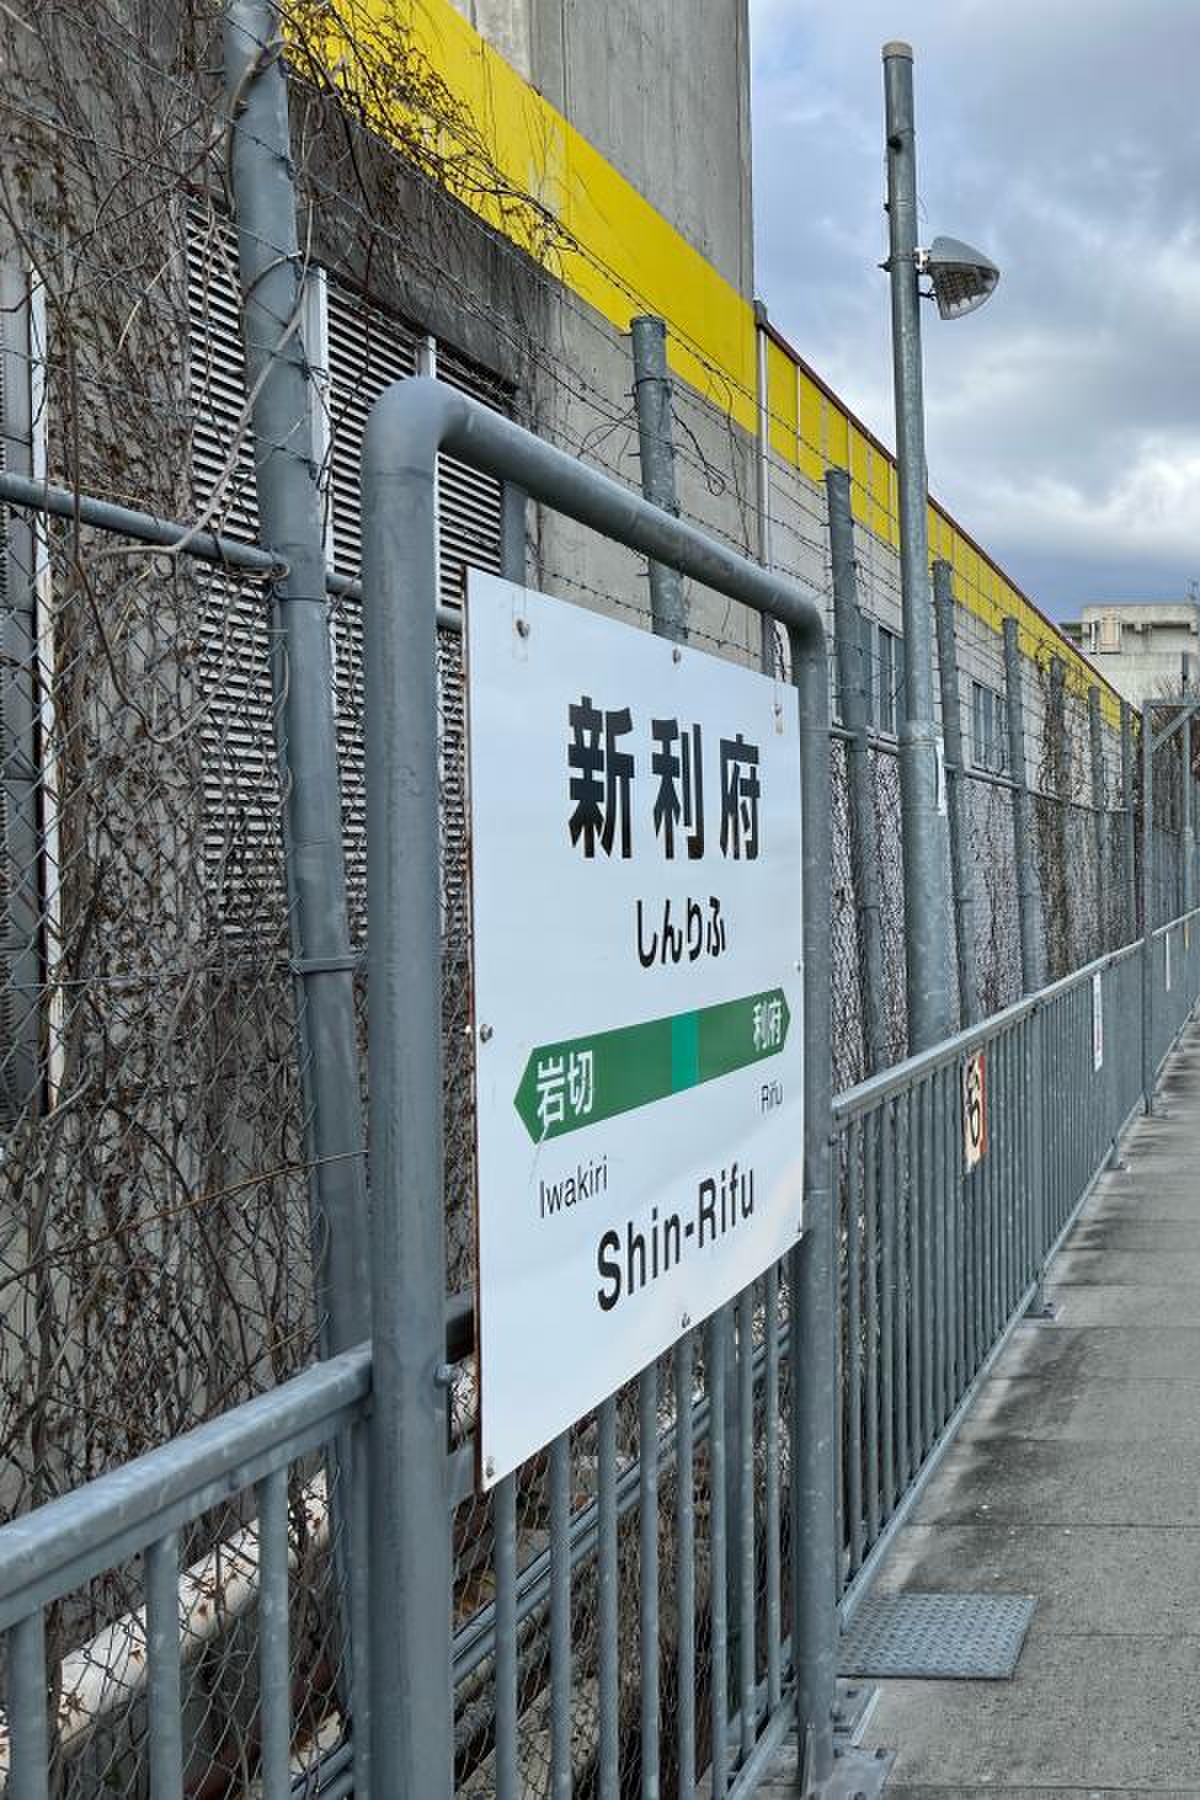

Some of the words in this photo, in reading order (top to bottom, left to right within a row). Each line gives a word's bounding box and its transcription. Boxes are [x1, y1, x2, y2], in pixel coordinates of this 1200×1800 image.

[568, 695, 760, 860] 新利府
[637, 896, 726, 967] しんりふ
[752, 998, 783, 1052] 利府
[537, 1050, 595, 1125] 岩切
[761, 1080, 784, 1114] Rifu
[540, 1154, 608, 1219] Iwakiri
[598, 1161, 755, 1312] Shin-Rifu
